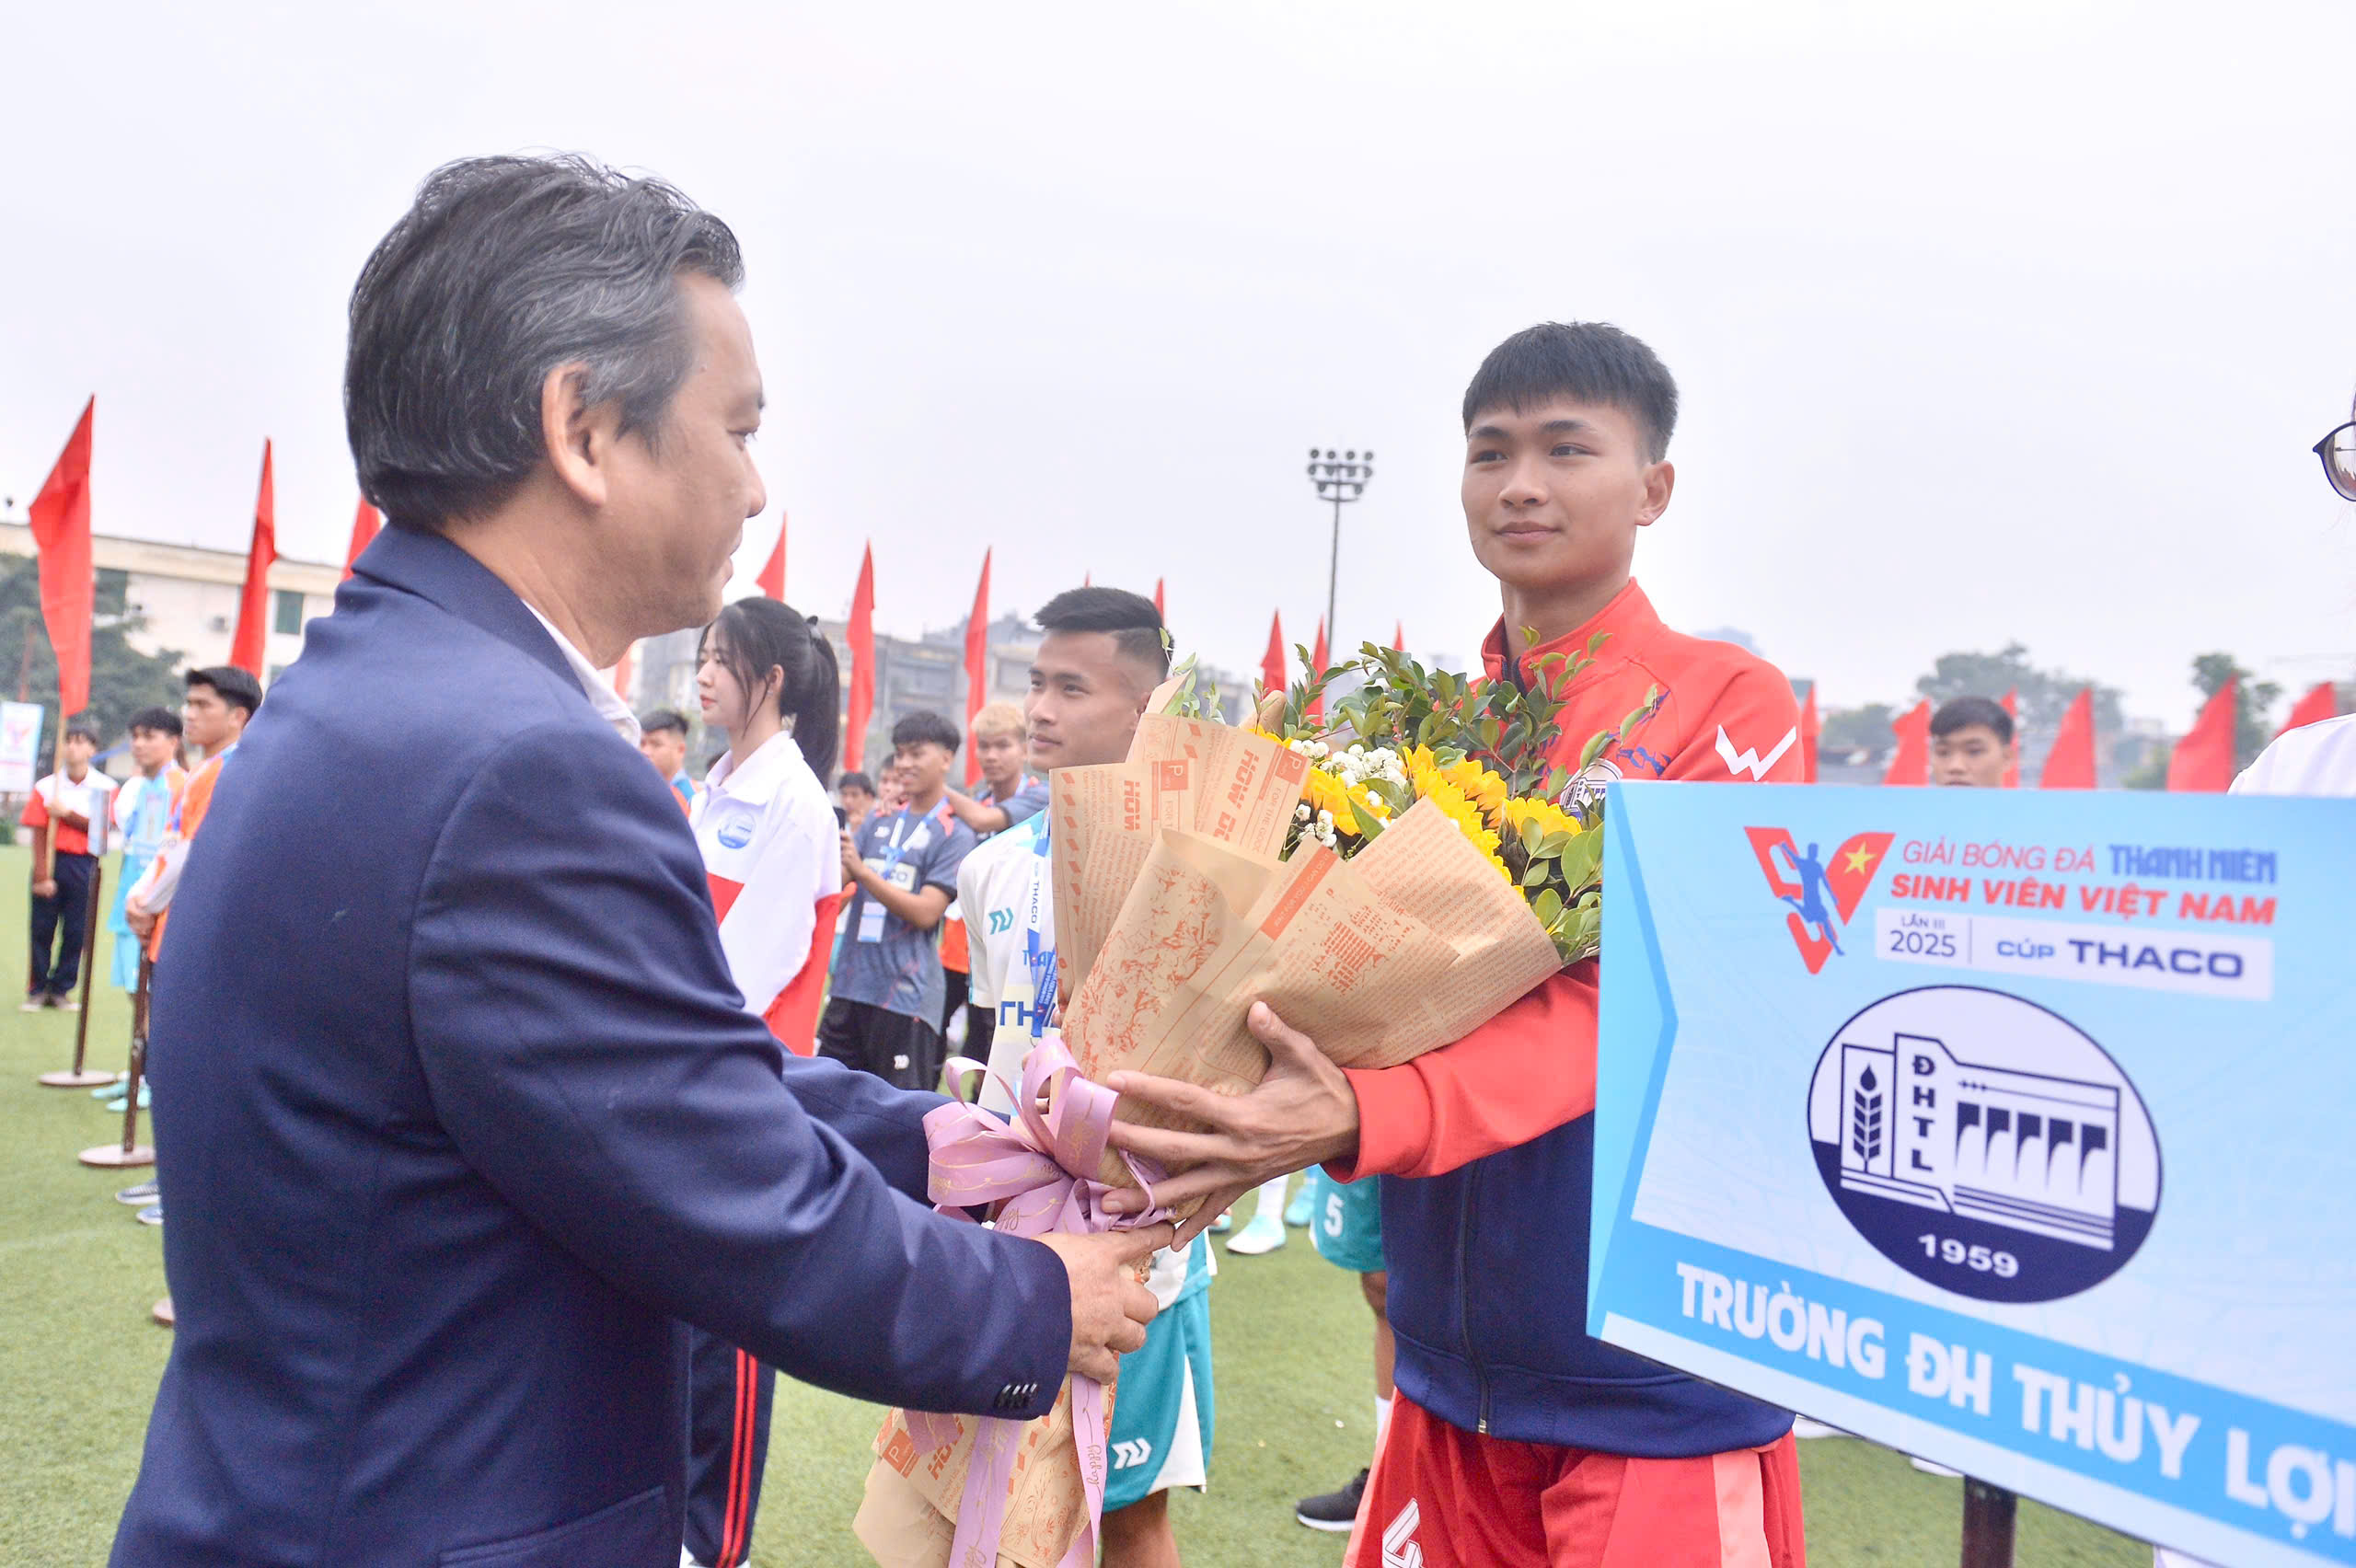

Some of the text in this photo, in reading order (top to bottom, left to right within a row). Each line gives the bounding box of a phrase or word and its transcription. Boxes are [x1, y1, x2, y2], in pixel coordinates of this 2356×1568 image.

[1228, 749, 1260, 810] HOW
[1902, 836, 1956, 865] GIẢI
[1961, 839, 2046, 870] BÓNG
[2053, 843, 2096, 873] ĐÁ
[2108, 844, 2202, 881] THANH
[1031, 881, 1041, 924] THACO
[1891, 872, 2278, 926] SINH VIÊN VIỆT NAM
[1890, 929, 1957, 958] 2025
[1997, 937, 2245, 979] CÚP THACO
[1323, 1192, 1345, 1237] 5
[1918, 1233, 2019, 1278] 1959
[1677, 1261, 2356, 1539] TRƯỜNG ĐH THỦY LỢI
[1086, 1442, 1103, 1486] happy
